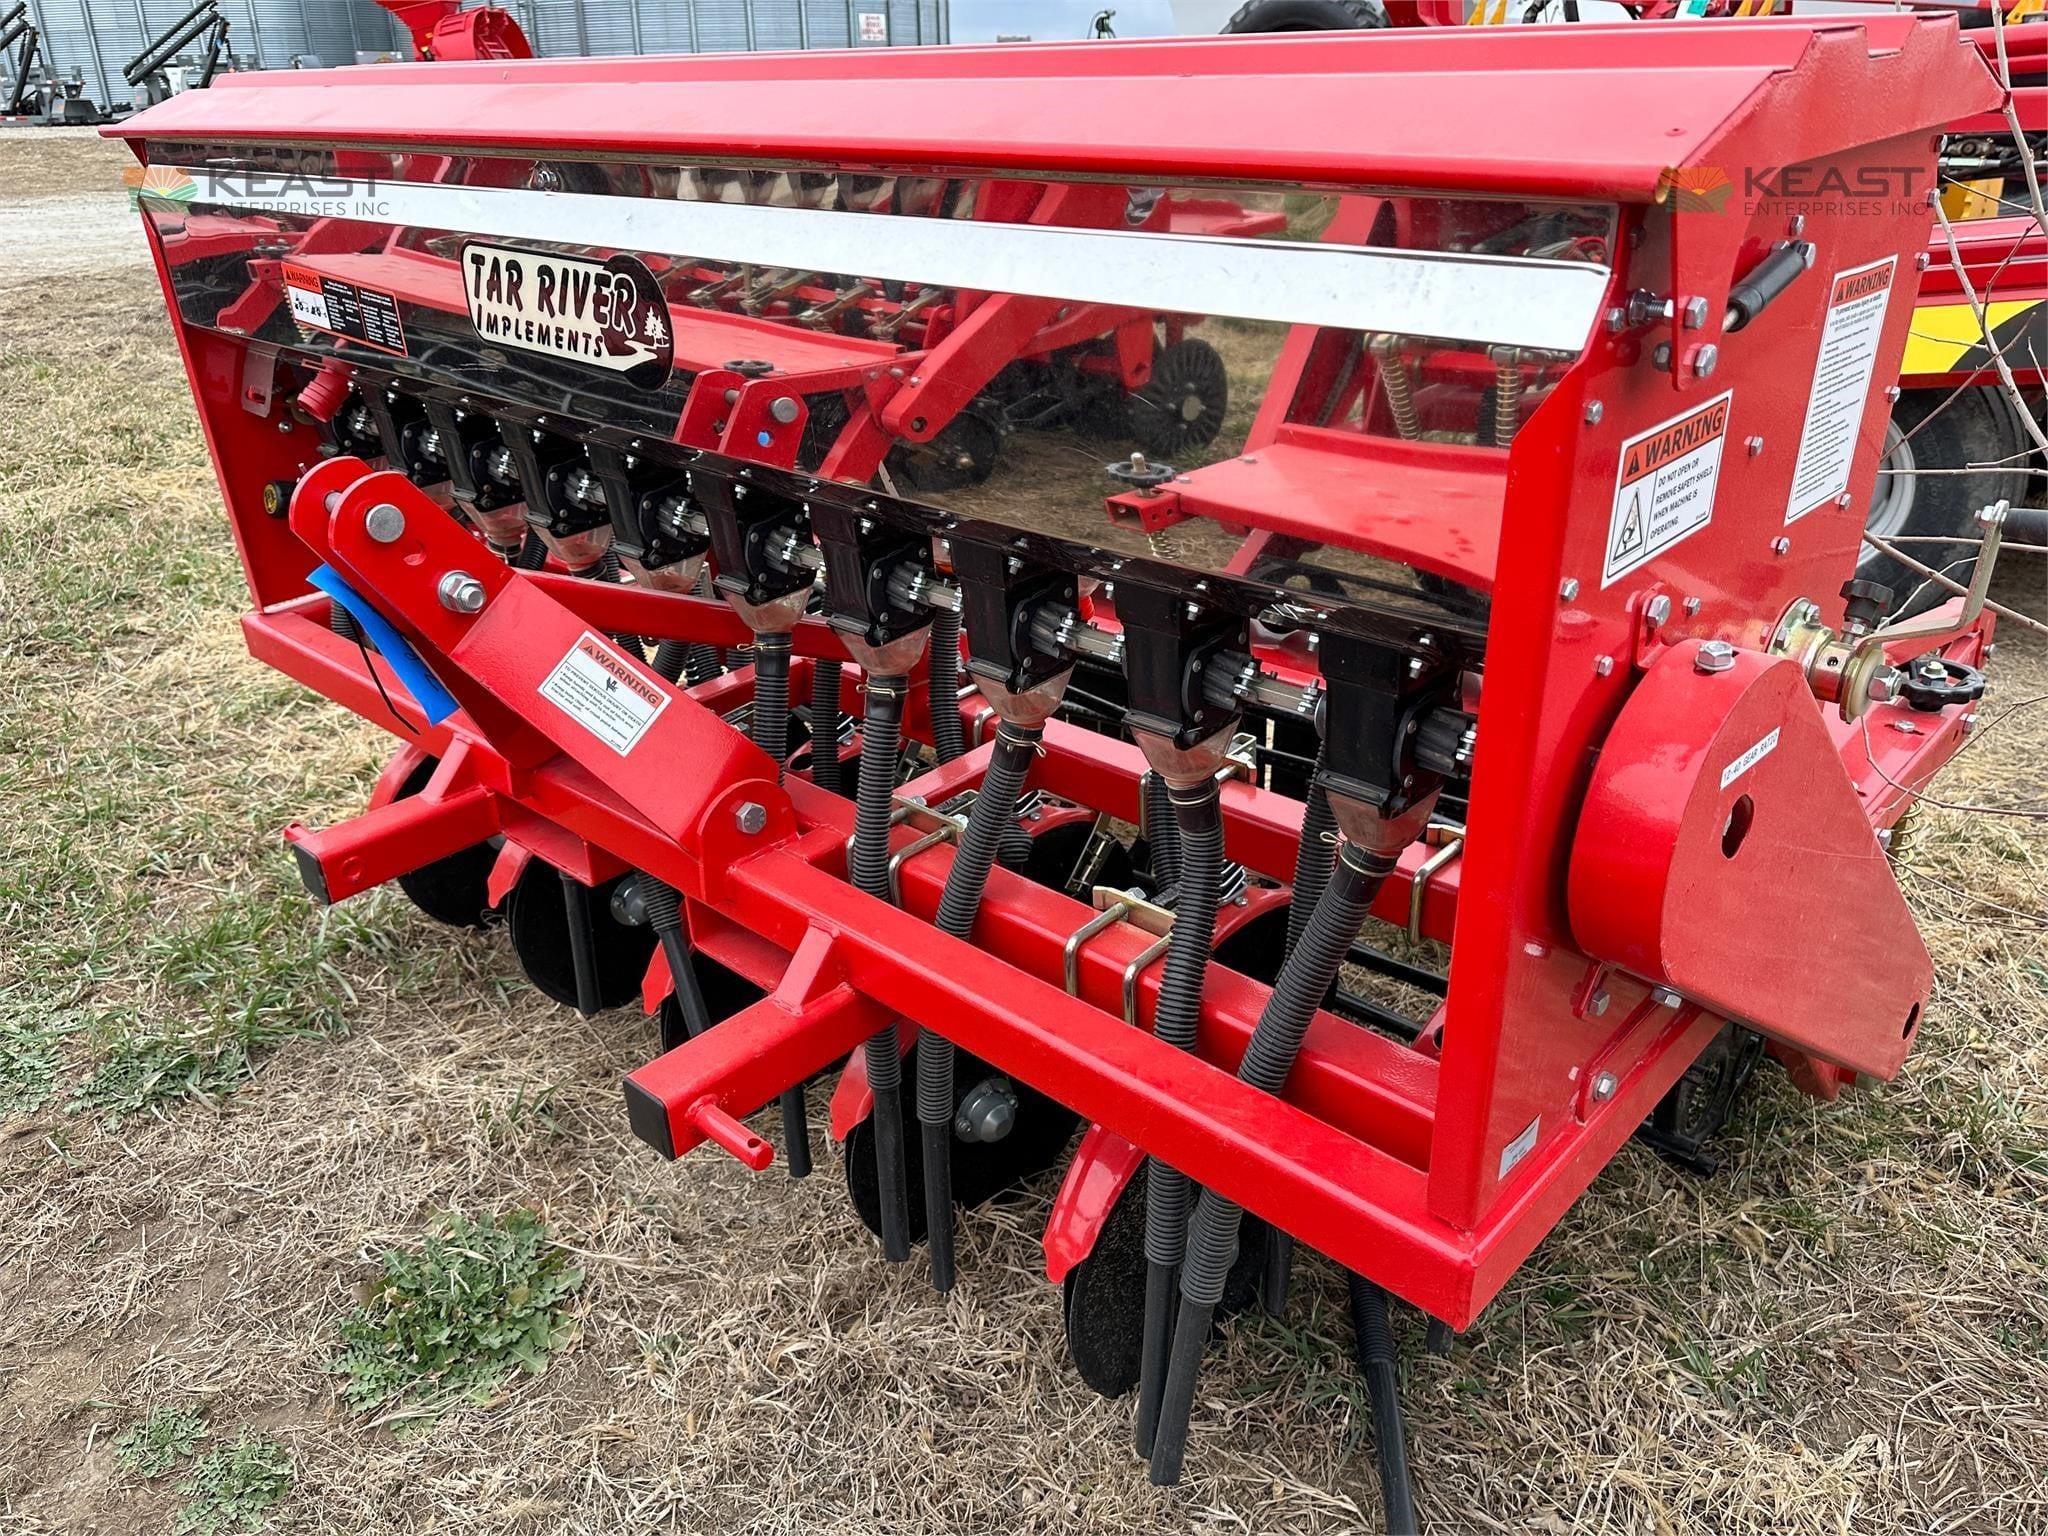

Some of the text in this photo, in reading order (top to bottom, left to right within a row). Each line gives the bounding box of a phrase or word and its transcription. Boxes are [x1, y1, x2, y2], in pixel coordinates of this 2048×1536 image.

[290, 270, 319, 288] WARNING
[471, 253, 637, 338] TAR RIVER
[1845, 268, 1890, 300] WARNING
[477, 303, 605, 358] IMPLEMENTS
[1646, 406, 1723, 467] WARNING
[1656, 465, 1713, 504] REMOVE SAFETY SHIELD
[1658, 457, 1699, 487] DO NOT OPEN OR
[1653, 489, 1698, 521] WHEN MACHINE IS
[594, 650, 659, 705] WARNING
